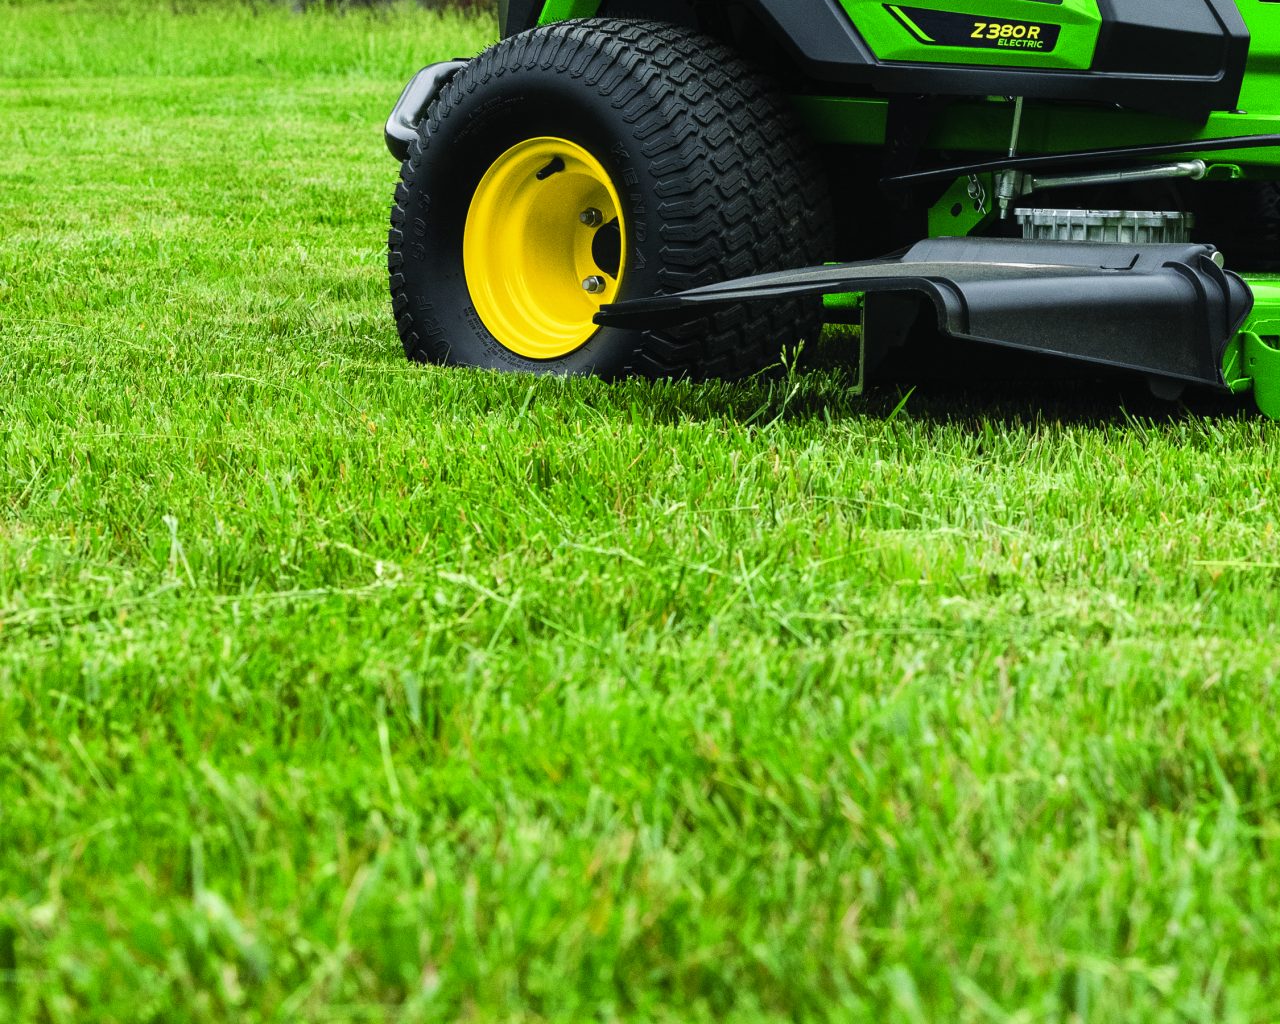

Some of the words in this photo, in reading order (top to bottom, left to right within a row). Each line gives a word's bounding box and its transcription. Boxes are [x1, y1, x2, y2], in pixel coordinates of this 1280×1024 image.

[997, 38, 1044, 49] ELECTRIC
[610, 139, 648, 272] KENDA
[414, 295, 451, 362] URF
